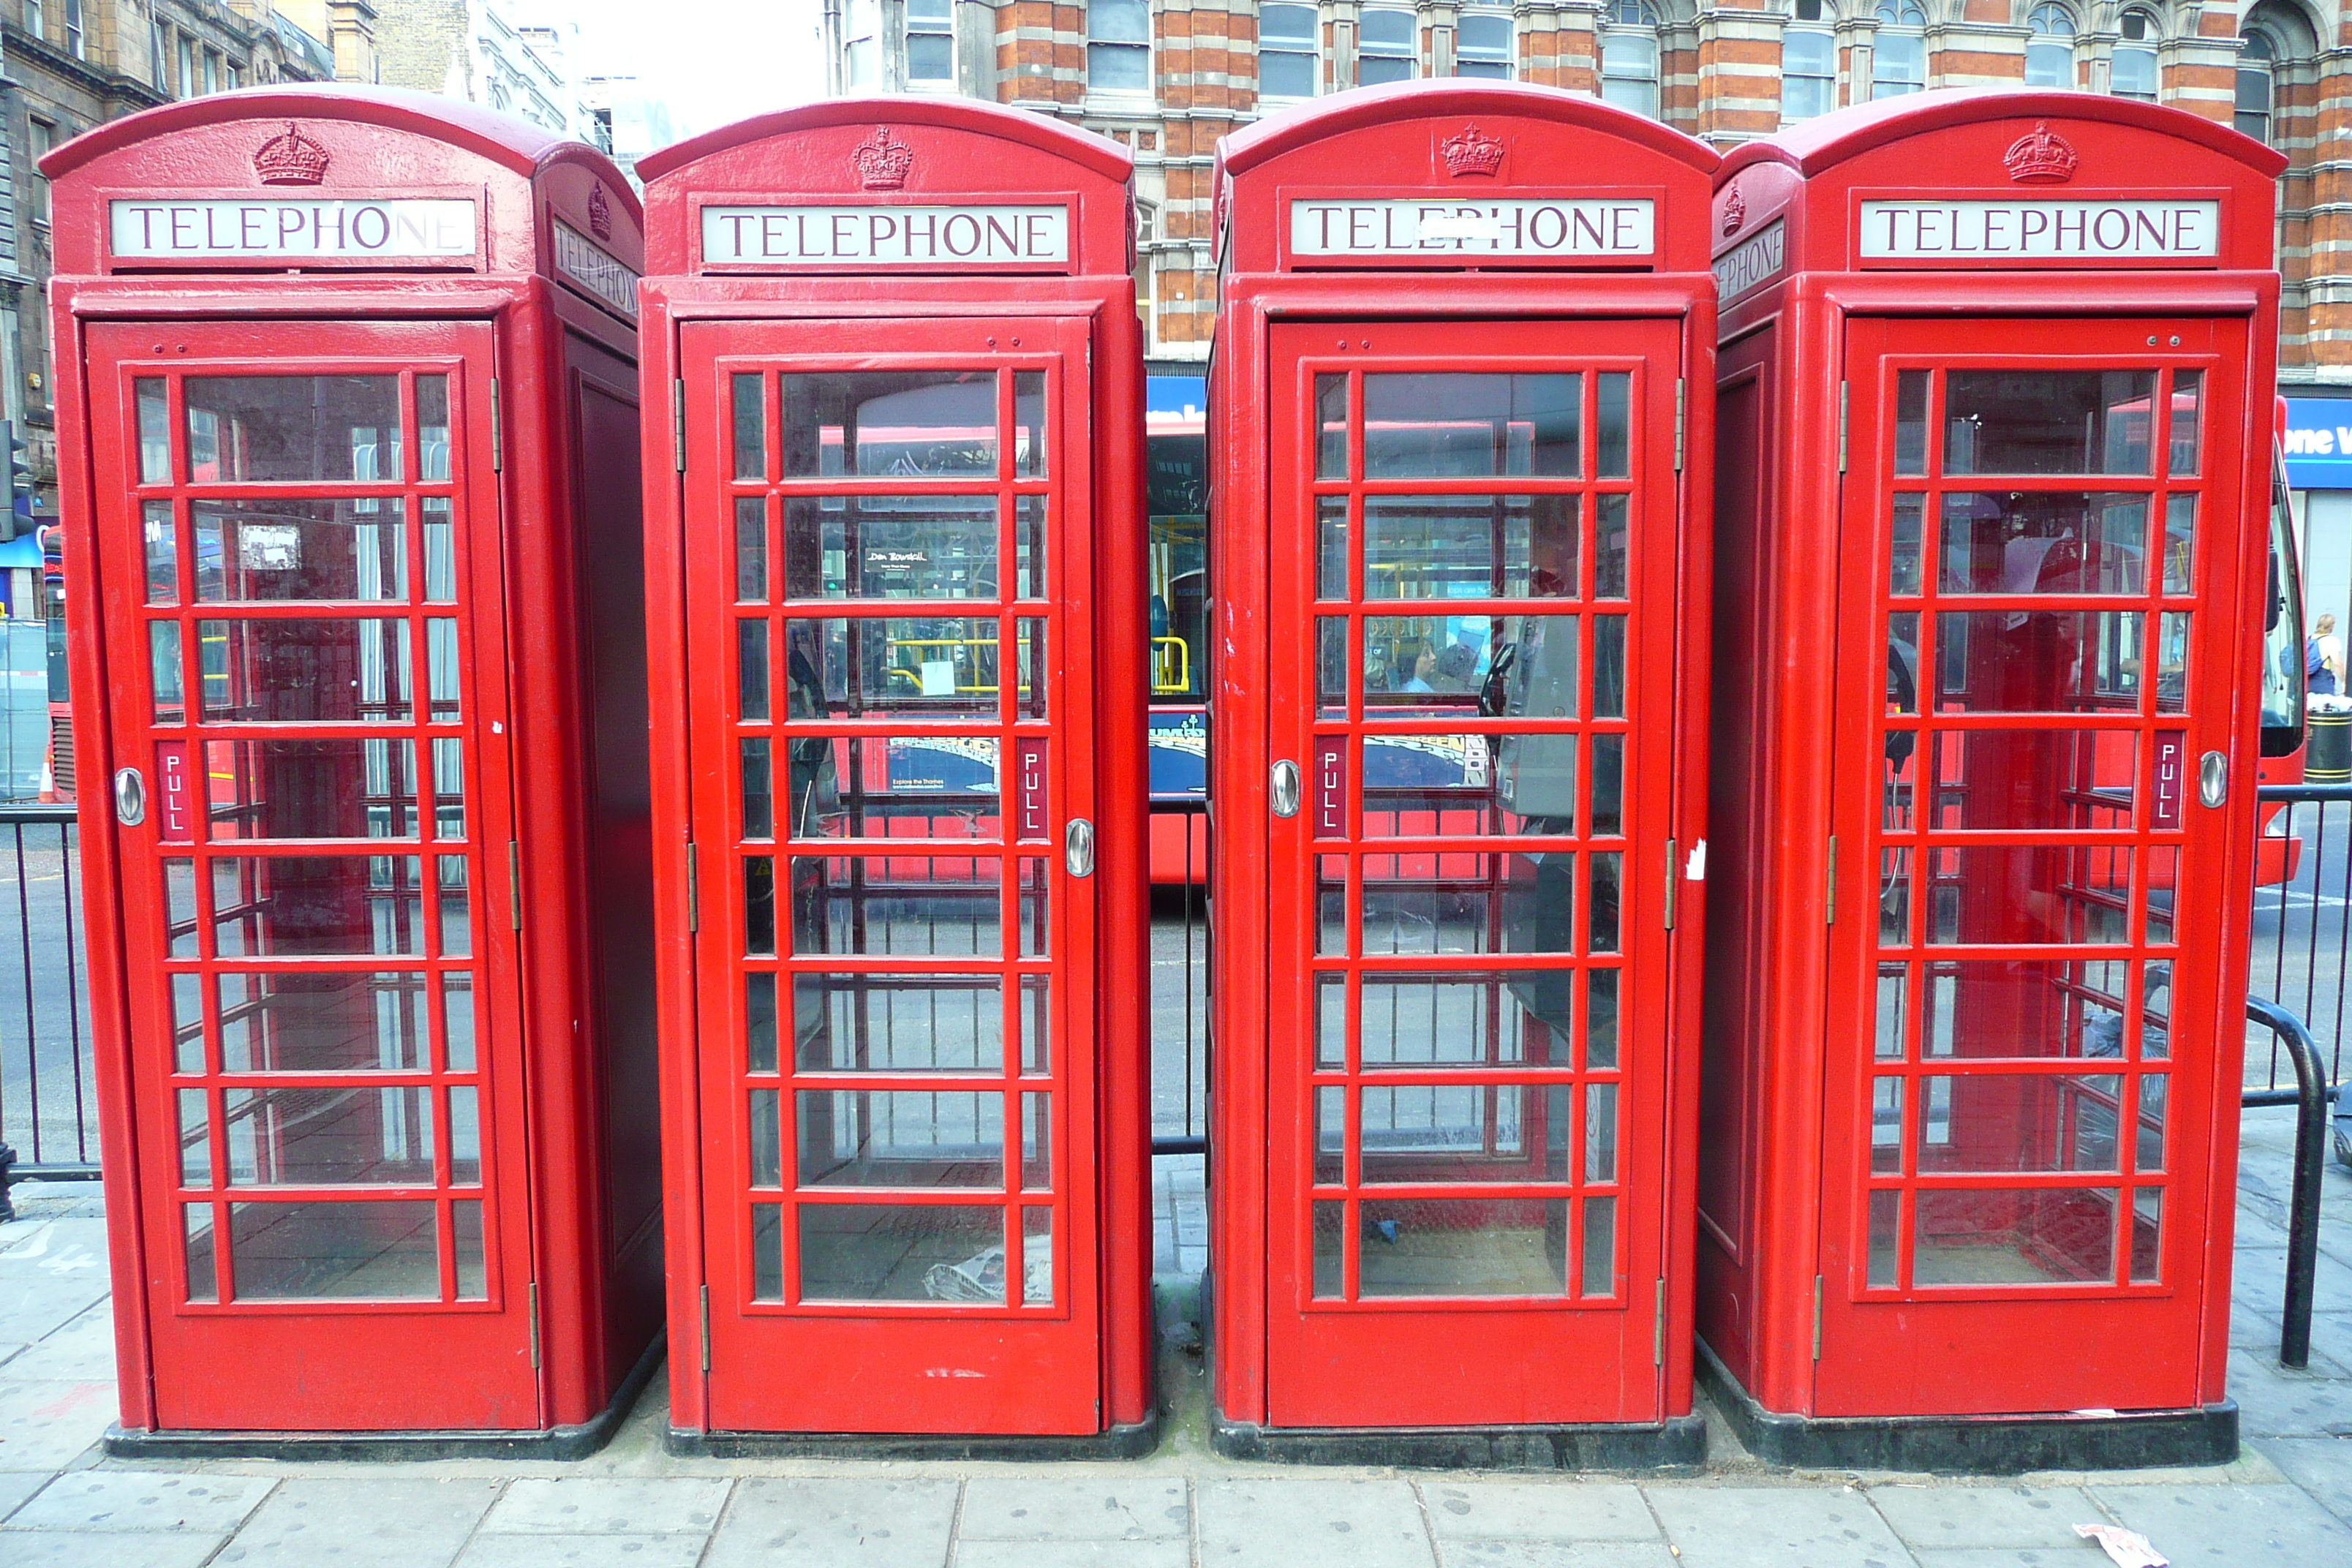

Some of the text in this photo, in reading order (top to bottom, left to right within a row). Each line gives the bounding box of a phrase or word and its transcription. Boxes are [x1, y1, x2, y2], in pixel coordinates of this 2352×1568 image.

[129, 207, 464, 249] TELEPHONE
[720, 214, 1054, 257] TELEPHONE
[1875, 209, 2201, 250] TELEPHONE
[167, 755, 184, 830] PULL
[1025, 753, 1039, 829] PULL
[1324, 753, 1337, 827] PULL
[2159, 745, 2174, 818] PULL
